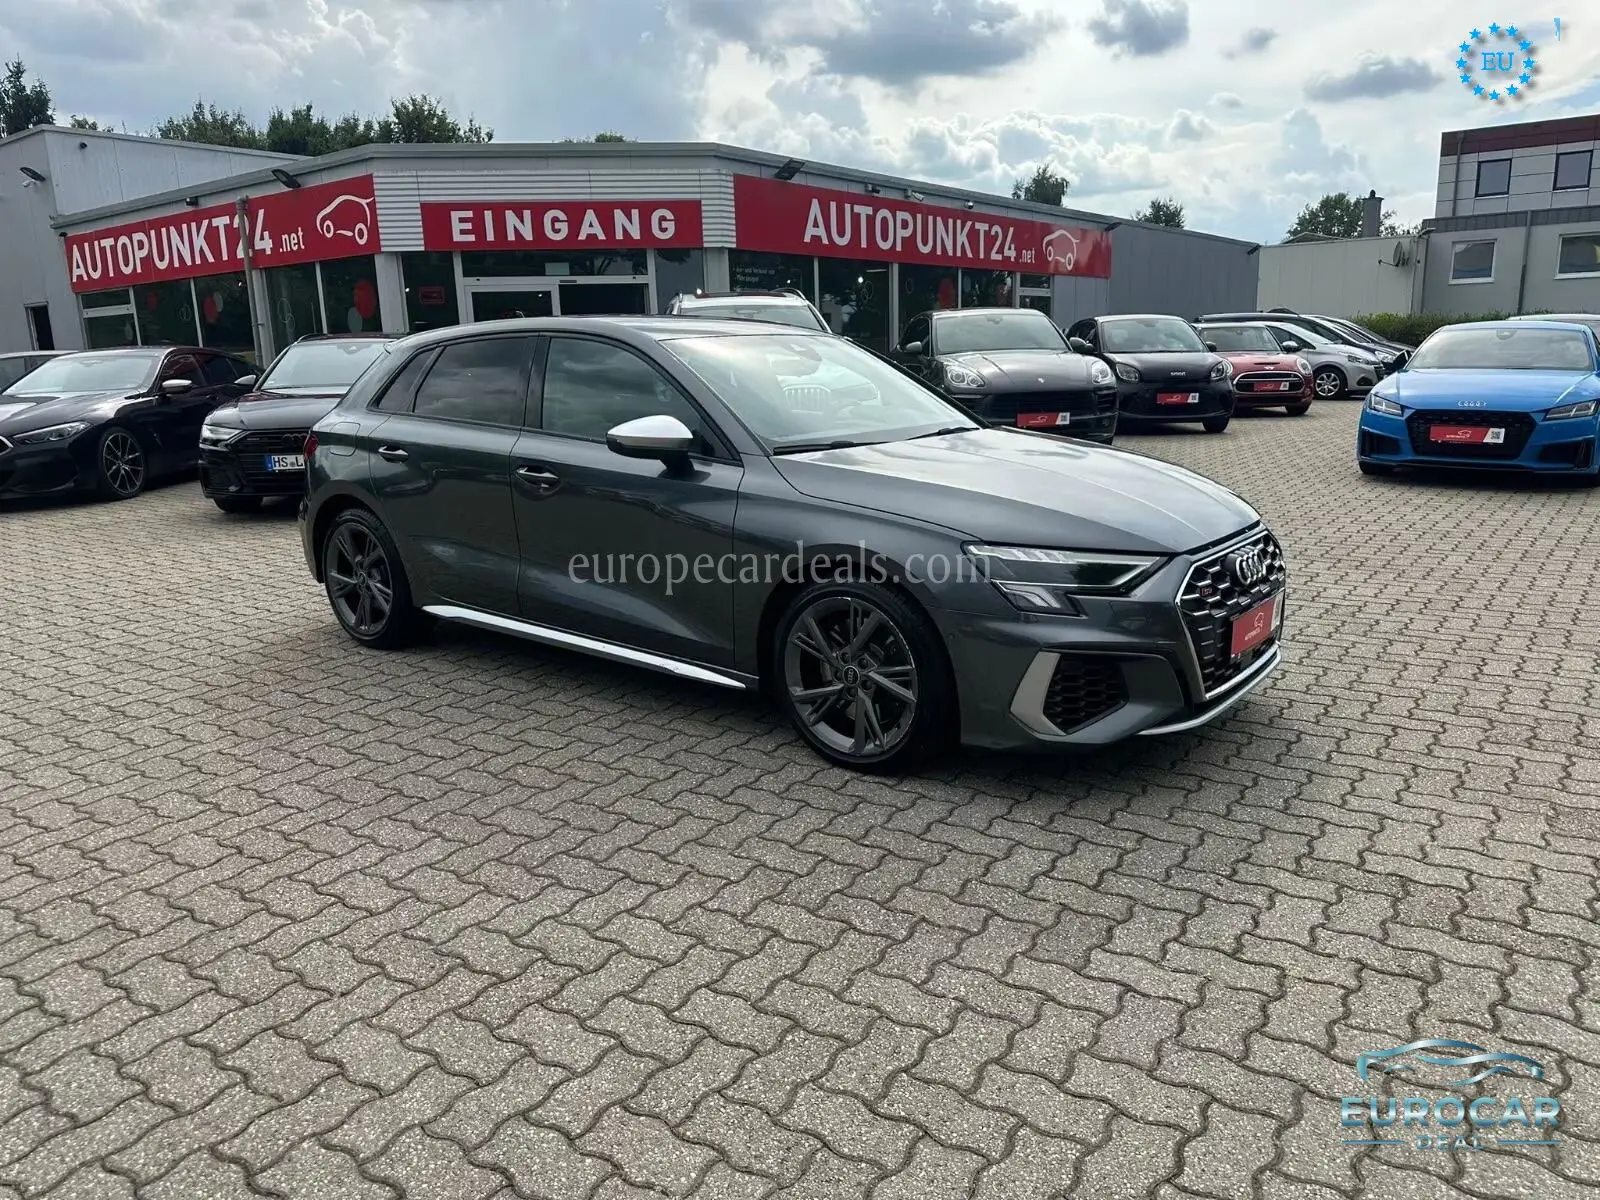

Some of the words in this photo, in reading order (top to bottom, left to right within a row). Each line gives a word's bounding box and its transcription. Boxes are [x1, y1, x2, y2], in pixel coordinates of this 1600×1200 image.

[279, 226, 305, 253] .net
[450, 208, 676, 242] EINGANG
[803, 198, 1016, 262] AUTOPUNKT24
[1019, 247, 1036, 264] .net
